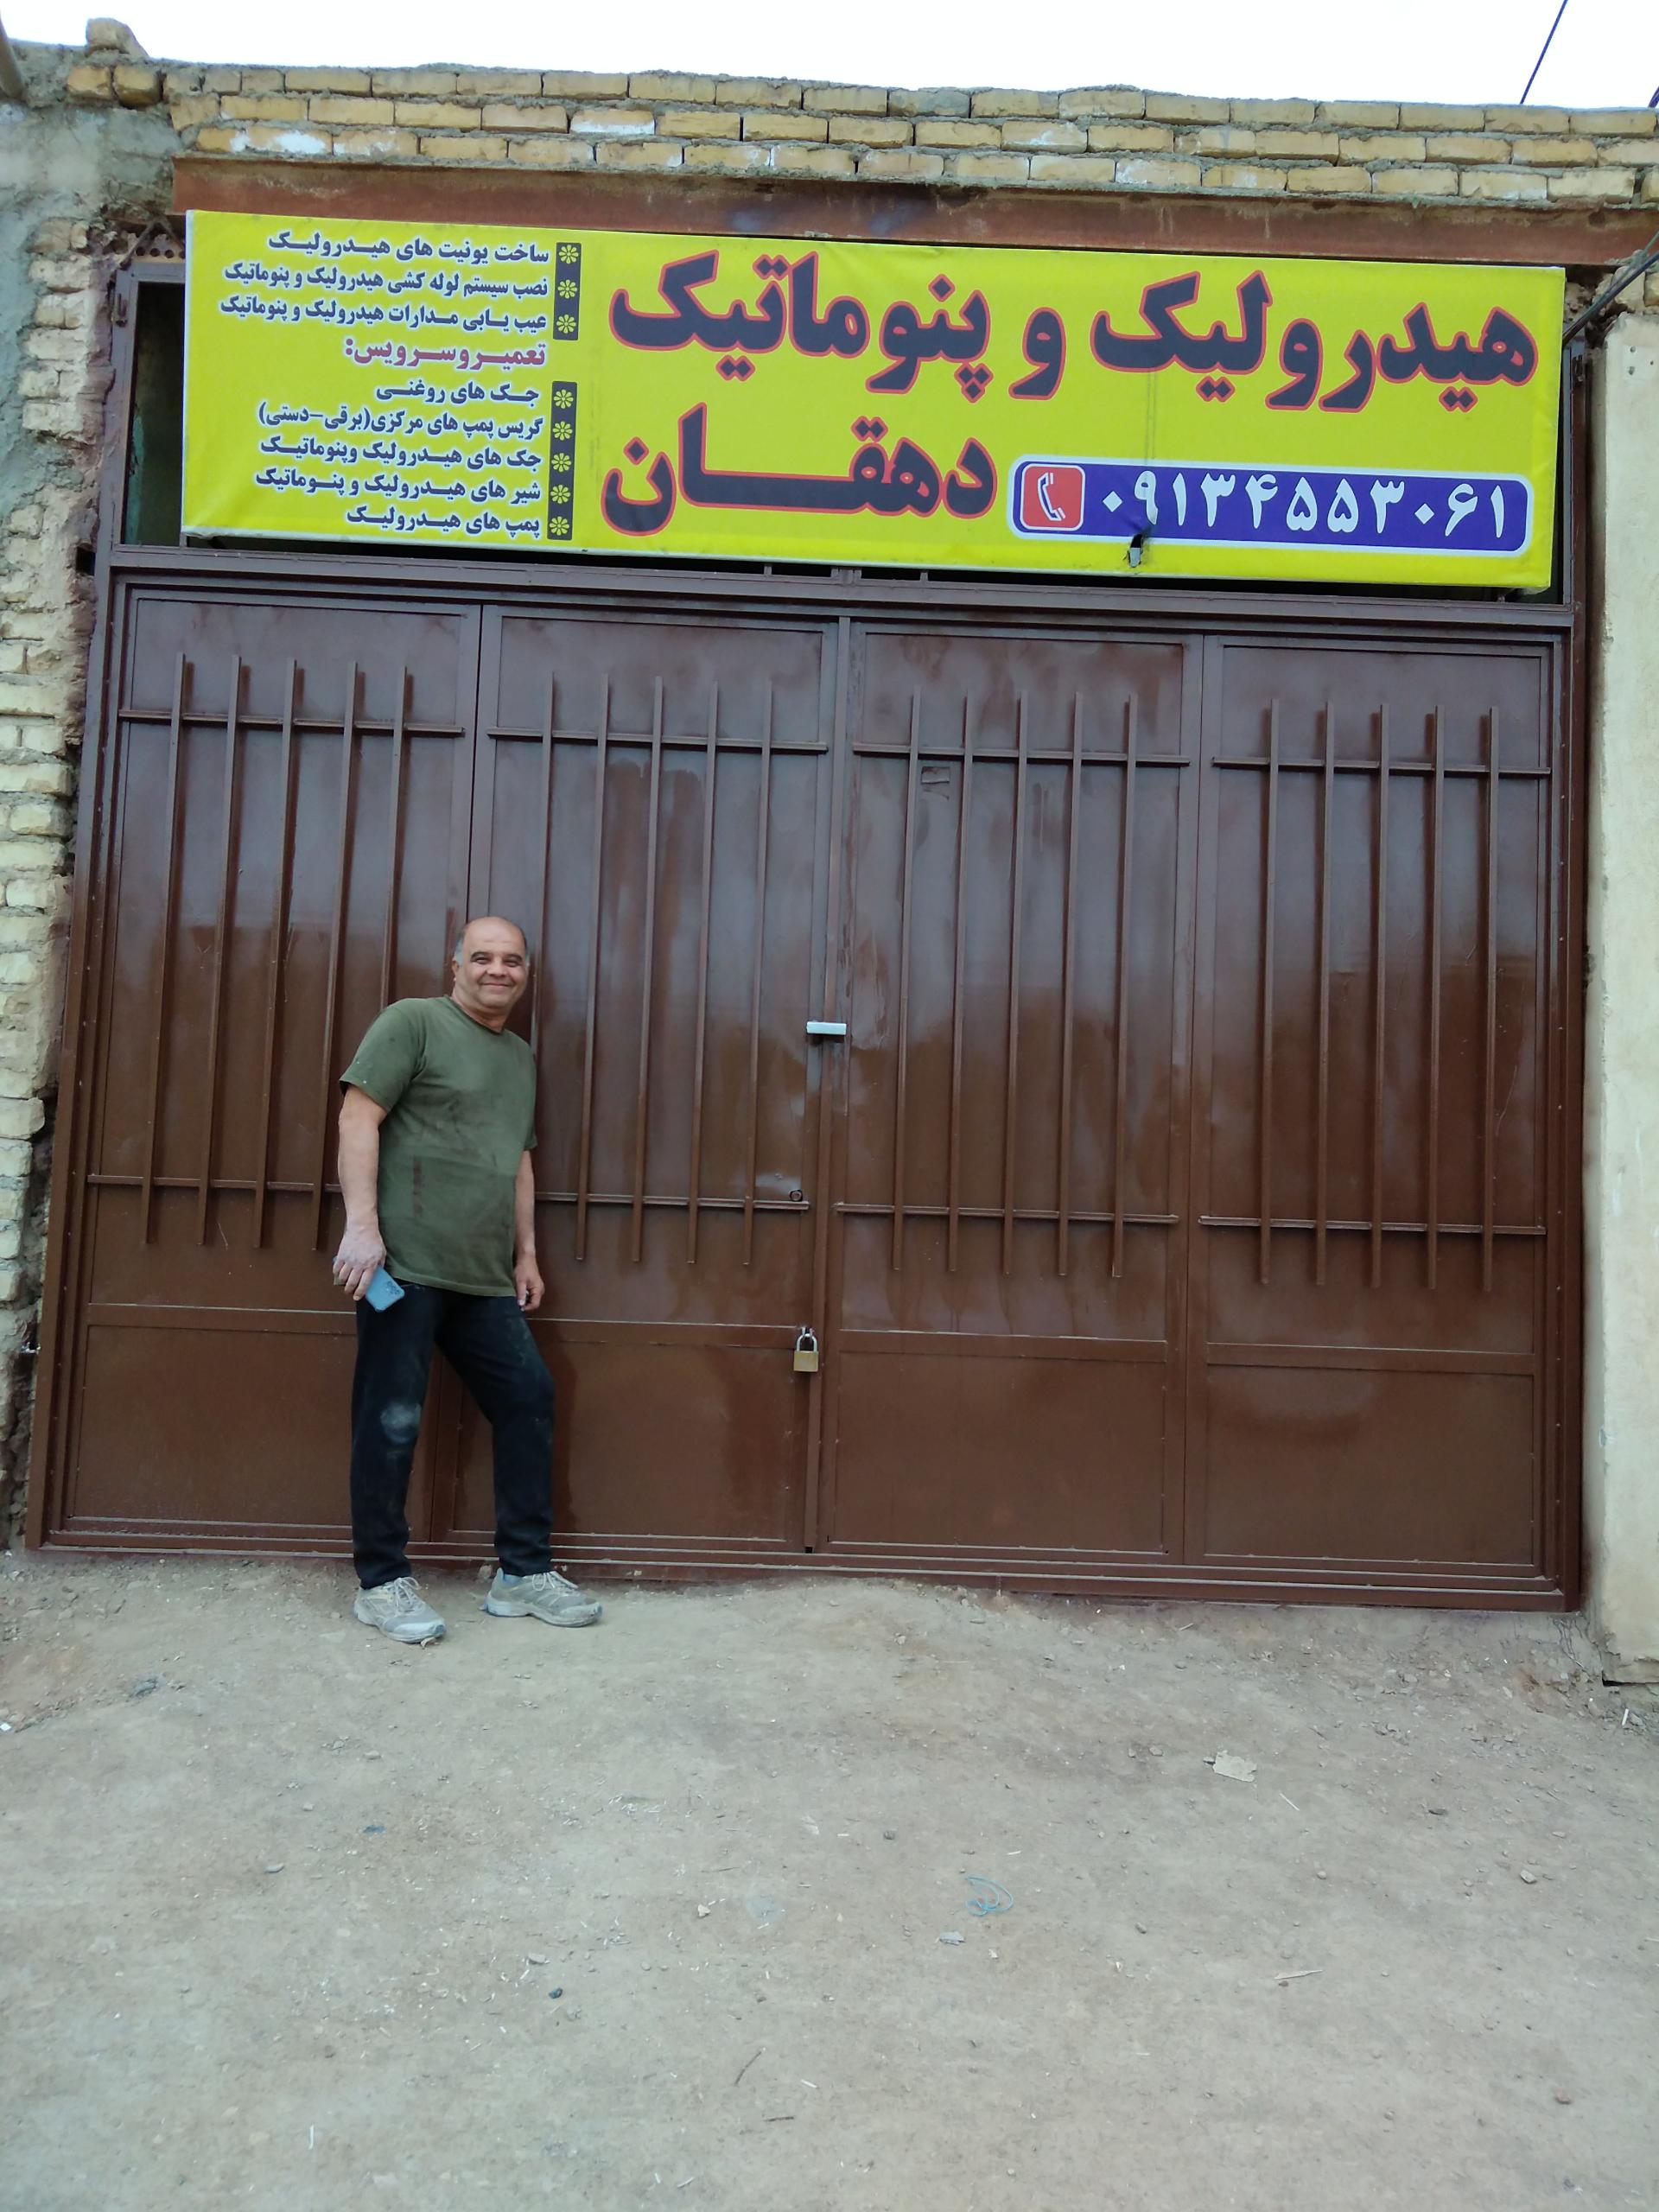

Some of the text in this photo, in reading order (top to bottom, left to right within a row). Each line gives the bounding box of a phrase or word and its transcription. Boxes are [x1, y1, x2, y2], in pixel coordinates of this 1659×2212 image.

[269, 231, 550, 265] ساخت یونیت های هیدرولیک
[225, 262, 548, 300] نصب سیستم لوله کشی هیدرولیک و پنوماتیک
[220, 295, 547, 334] عیب یابی مدارات هیدرولیک و پنوماتیک
[608, 250, 1539, 414] هیدرولیک و پنوماتیک
[376, 378, 539, 408] جک های روغنی
[427, 411, 459, 435] های
[462, 420, 494, 439] پمپ
[497, 417, 543, 441] گریس
[362, 442, 463, 467] هیدرولیک
[467, 447, 502, 470] های
[506, 448, 542, 472] جک
[601, 400, 998, 537] دهقان
[256, 467, 541, 505] شیر های هیدرولیک و پنوماتیک
[1101, 469, 1505, 539] ۰۹۱۳۴۵۵۳۰۶۱
[346, 505, 540, 538] پمپ های هیدرولیک
